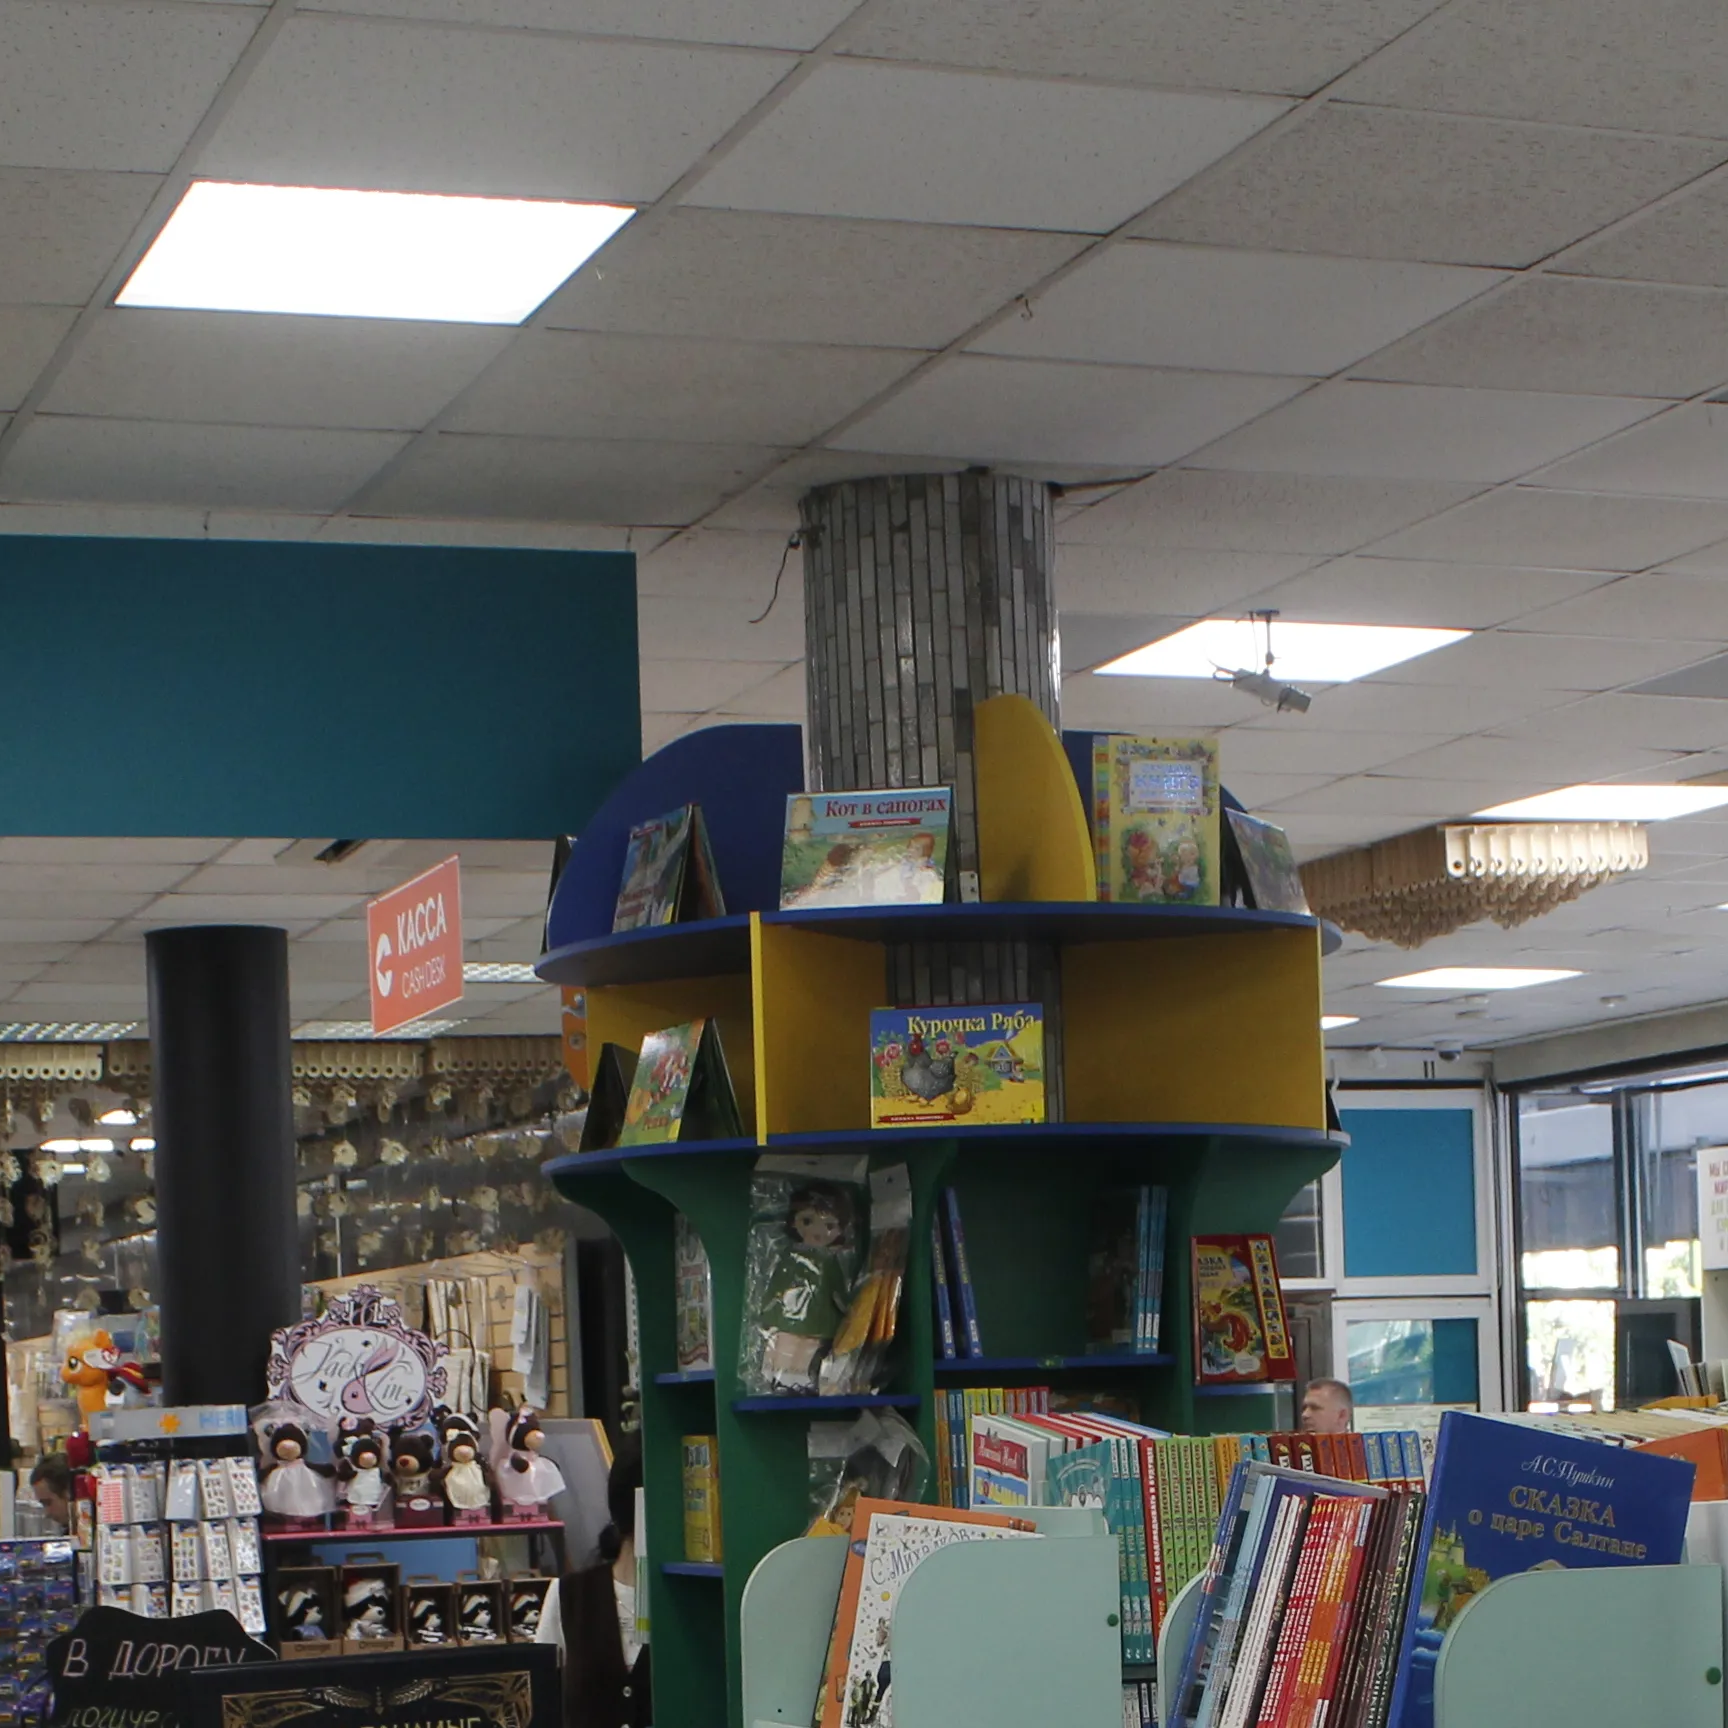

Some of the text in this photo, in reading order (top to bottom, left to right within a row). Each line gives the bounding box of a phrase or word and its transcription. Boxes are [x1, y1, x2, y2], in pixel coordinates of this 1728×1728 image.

[825, 799, 858, 817] Кот
[877, 798, 947, 815] сапогах
[396, 892, 448, 957] КАССА
[906, 1009, 1036, 1039] Курочка Ряба
[1508, 1484, 1616, 1529] СКАЗКА
[1489, 1511, 1545, 1542] царе
[1554, 1520, 1648, 1560] Салтане
[63, 1639, 90, 1679] В
